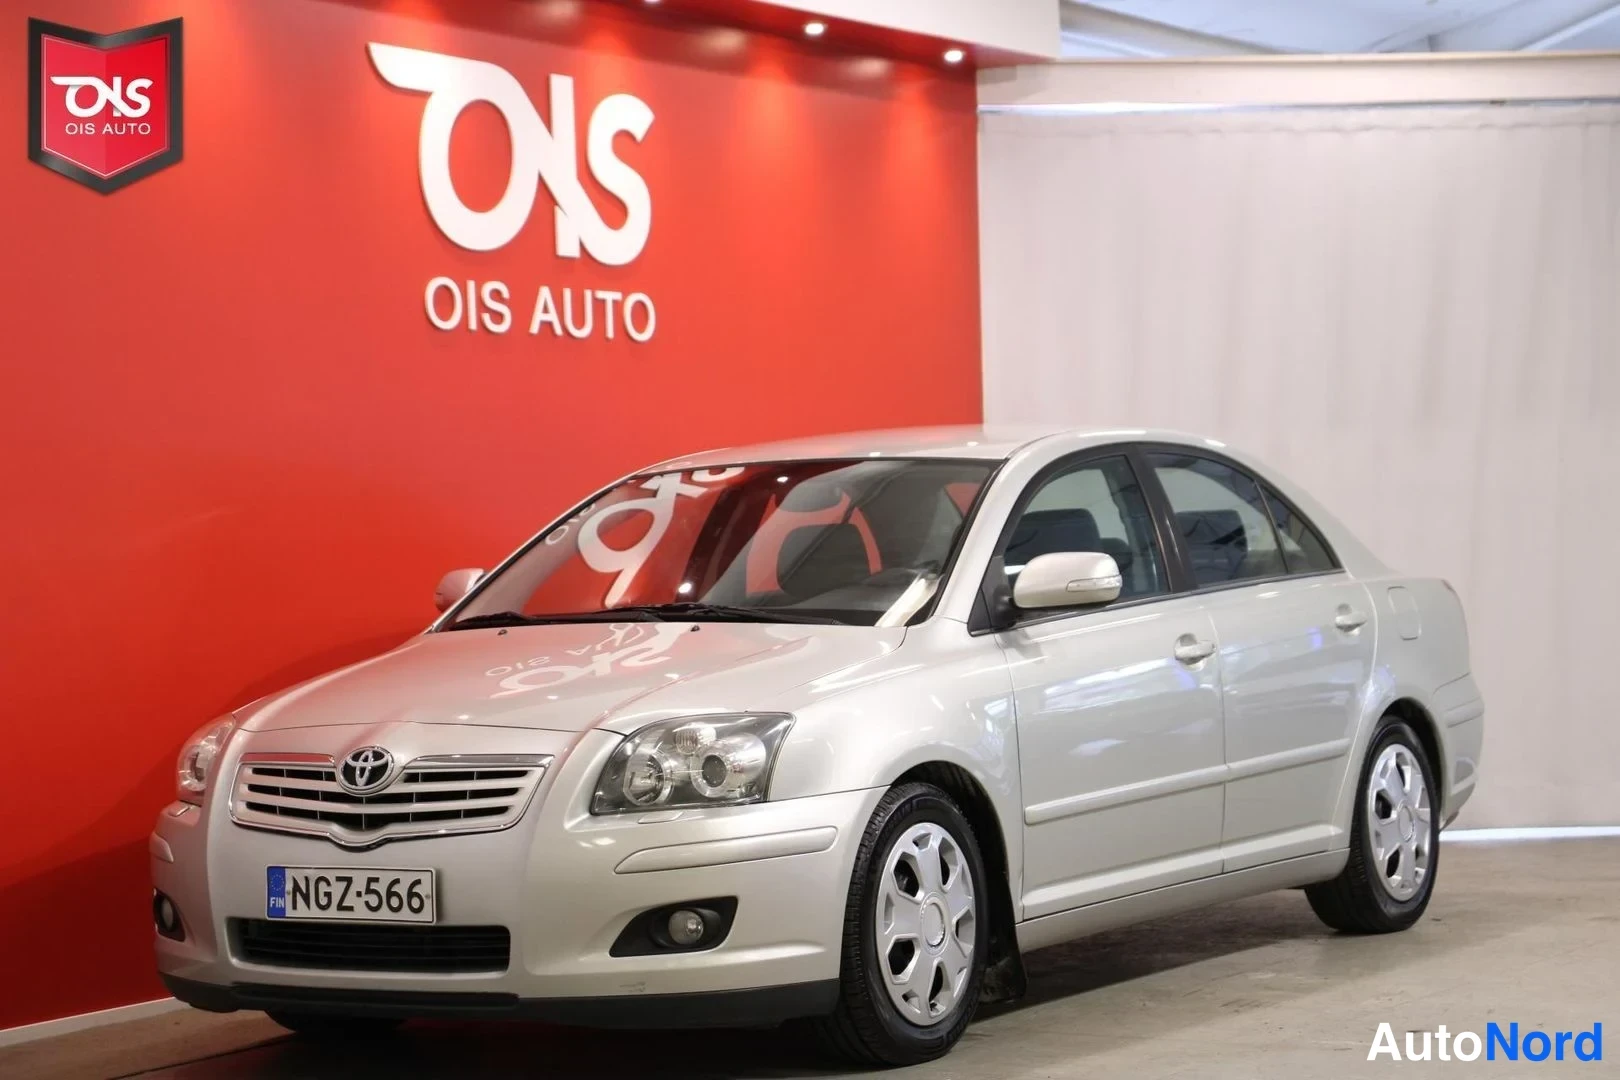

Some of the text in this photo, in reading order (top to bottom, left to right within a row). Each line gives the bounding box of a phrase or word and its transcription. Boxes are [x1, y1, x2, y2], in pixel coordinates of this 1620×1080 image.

[424, 276, 656, 342] OIS AUTO
[270, 897, 285, 908] FIN
